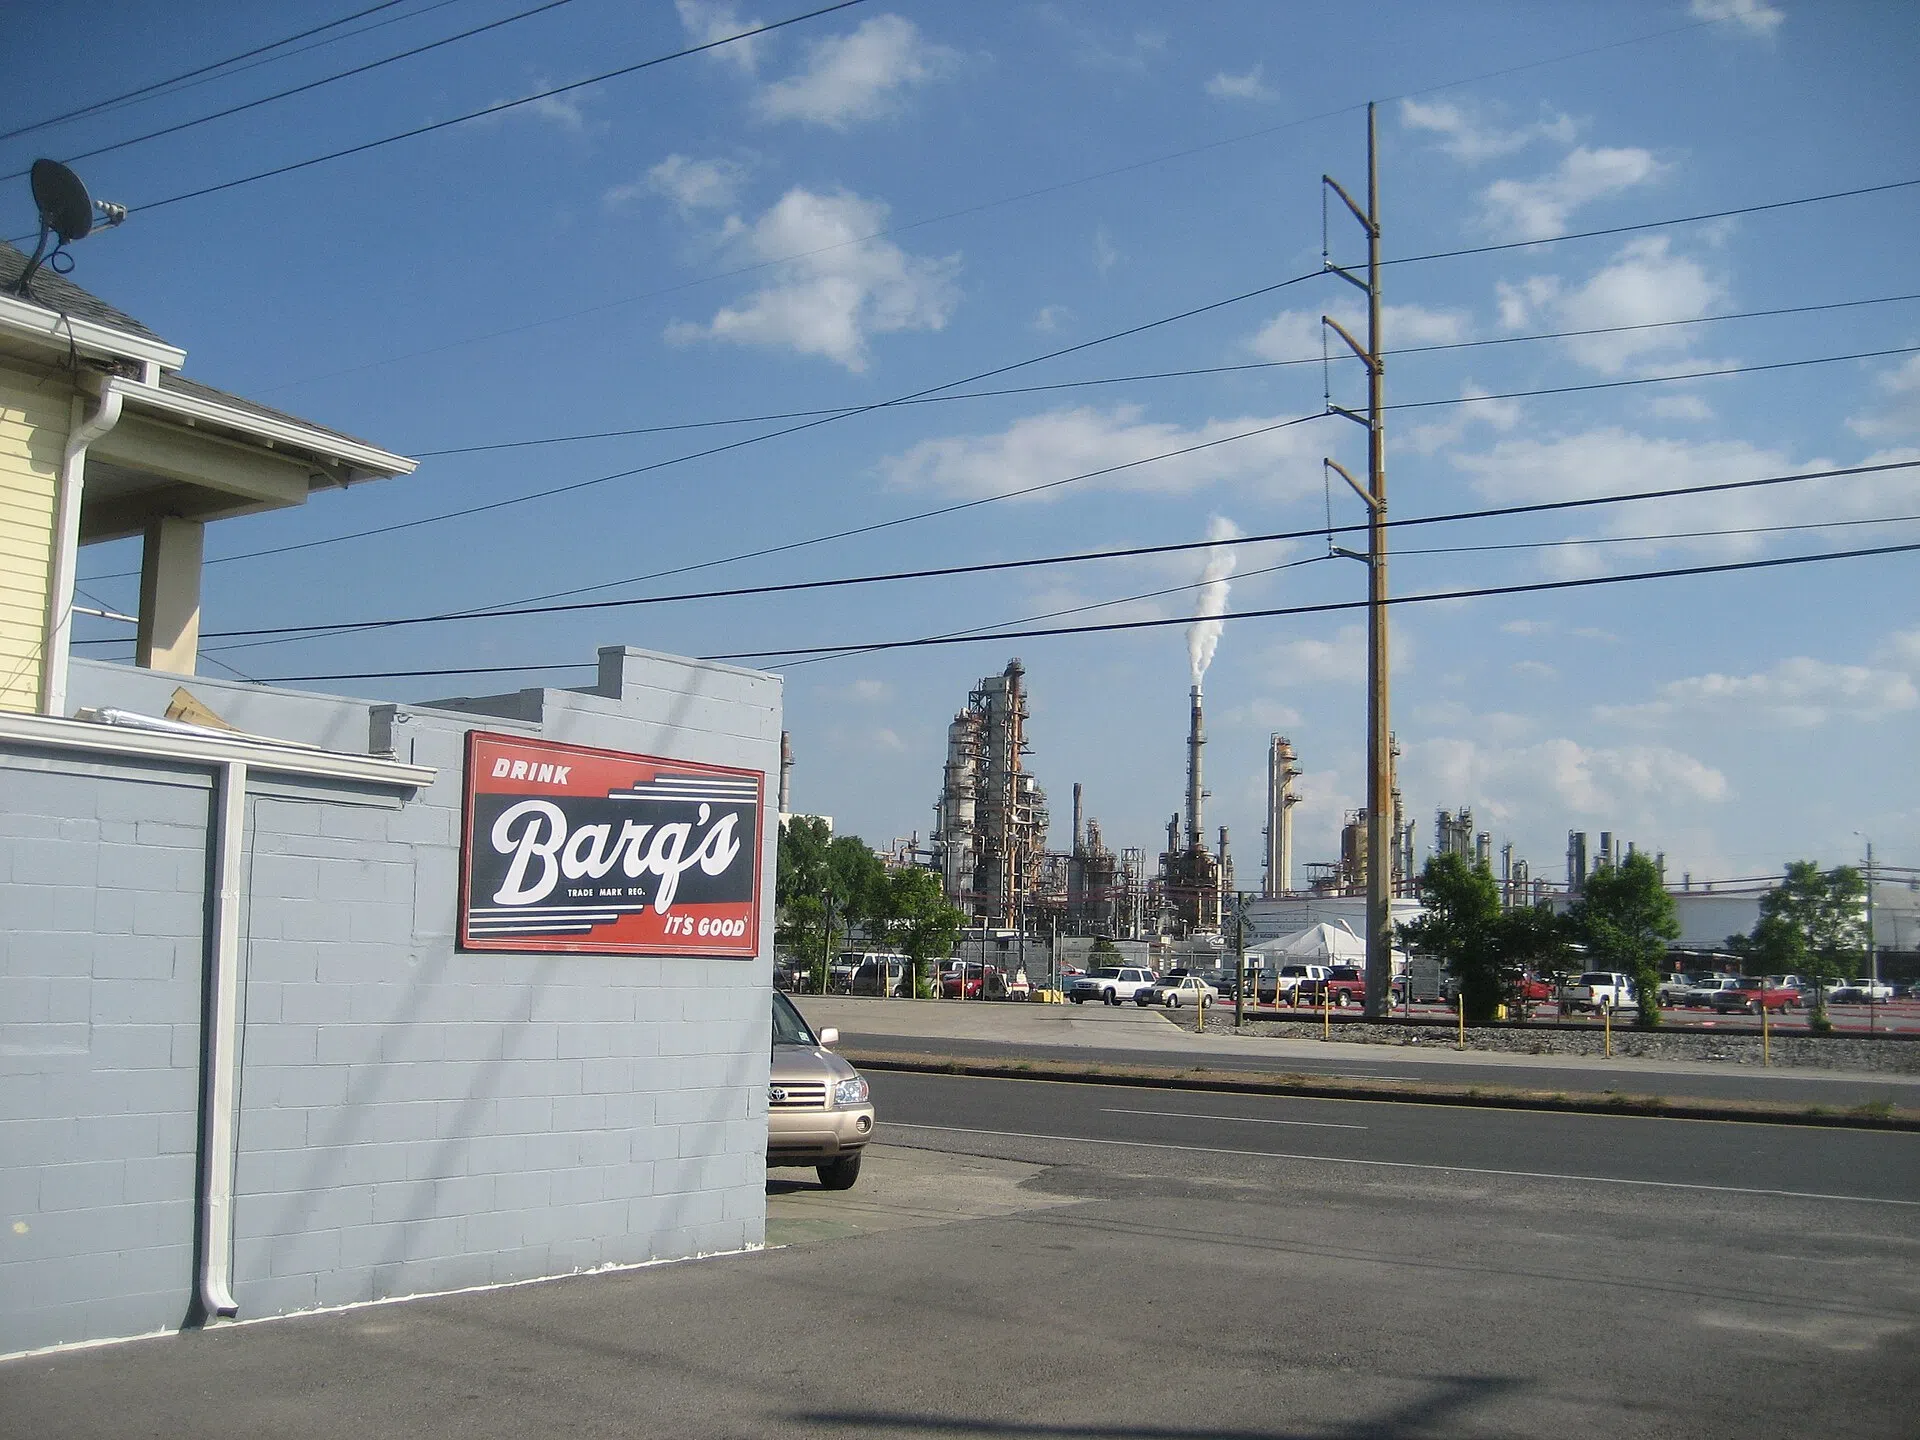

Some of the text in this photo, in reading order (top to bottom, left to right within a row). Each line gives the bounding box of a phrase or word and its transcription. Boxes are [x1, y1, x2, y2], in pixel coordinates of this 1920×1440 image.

[491, 757, 572, 785] DRINK
[491, 799, 741, 915] Barq's
[567, 887, 646, 898] TRADE MARK REG.
[1222, 893, 1256, 930] CROSSING
[1240, 915, 1256, 932] ROAD
